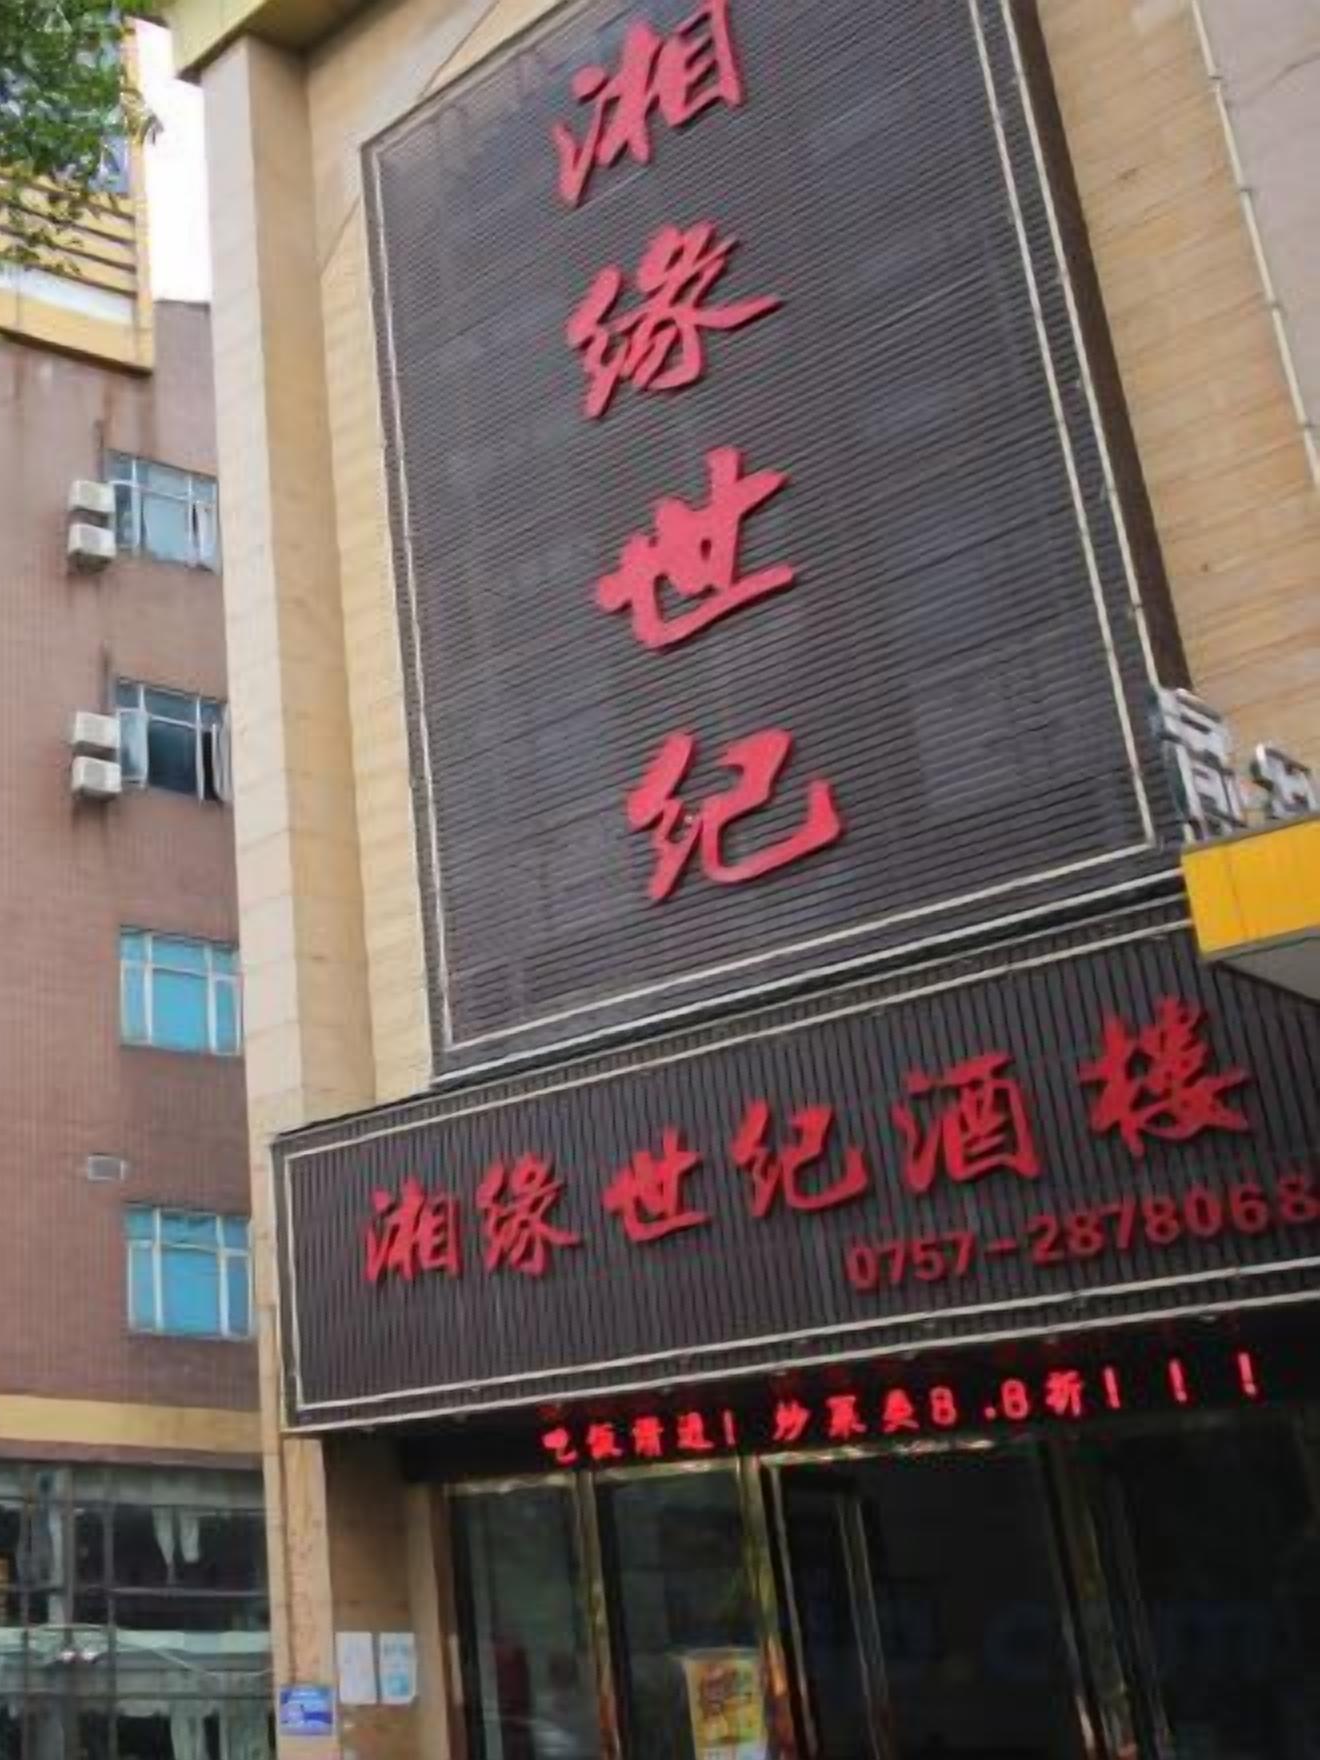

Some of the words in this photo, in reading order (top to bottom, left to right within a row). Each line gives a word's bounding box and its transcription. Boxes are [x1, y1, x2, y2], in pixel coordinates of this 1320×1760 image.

[553, 0, 845, 900] 湘缘世纪
[364, 996, 1247, 1282] 湘缘世纪酒楼
[844, 1174, 1320, 1290] 0757-2878068
